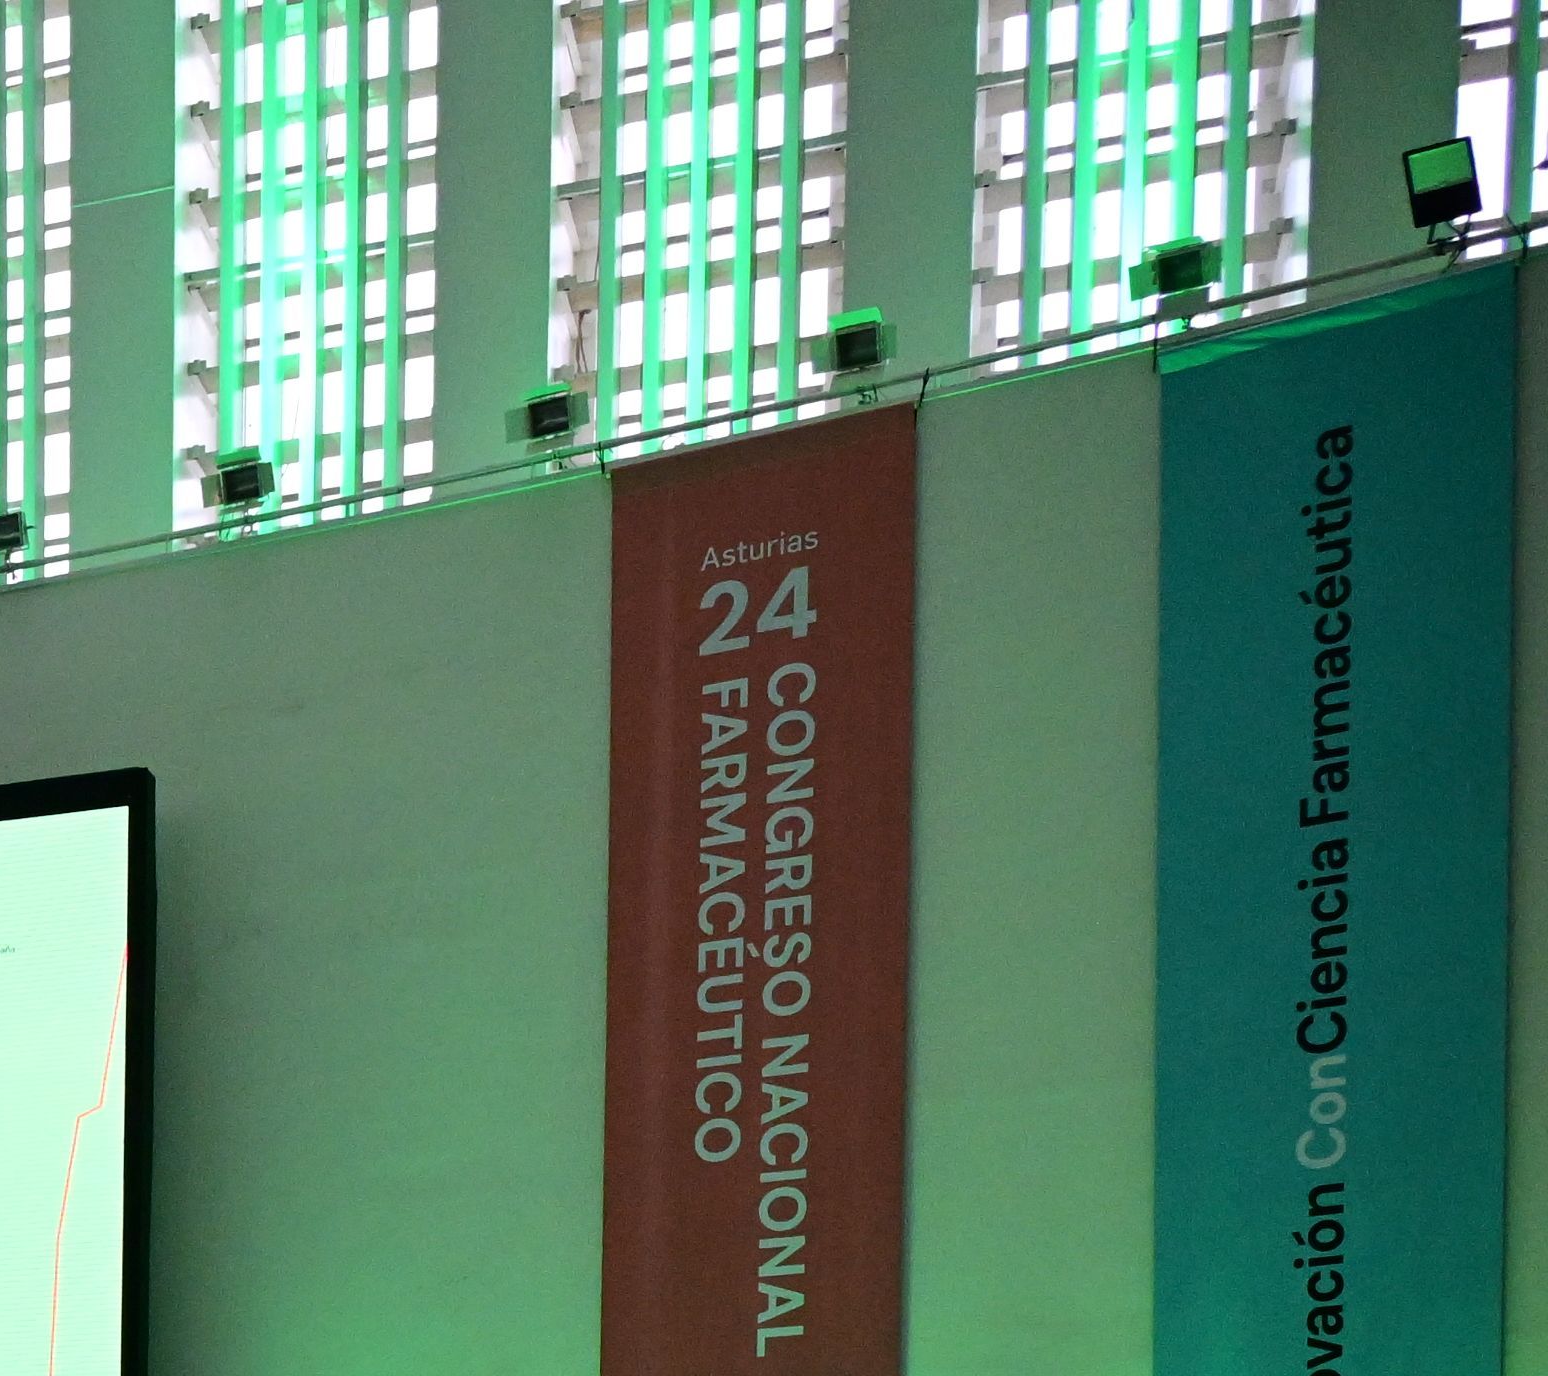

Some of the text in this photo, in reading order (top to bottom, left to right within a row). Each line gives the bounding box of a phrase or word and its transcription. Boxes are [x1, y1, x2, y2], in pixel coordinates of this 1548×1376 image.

[702, 529, 818, 570] Asturias
[1299, 424, 1354, 827] Farmacéutica
[694, 676, 759, 1162] FARMACÉUTICO
[699, 567, 817, 1357] 24 CONGRESO NACIONAL
